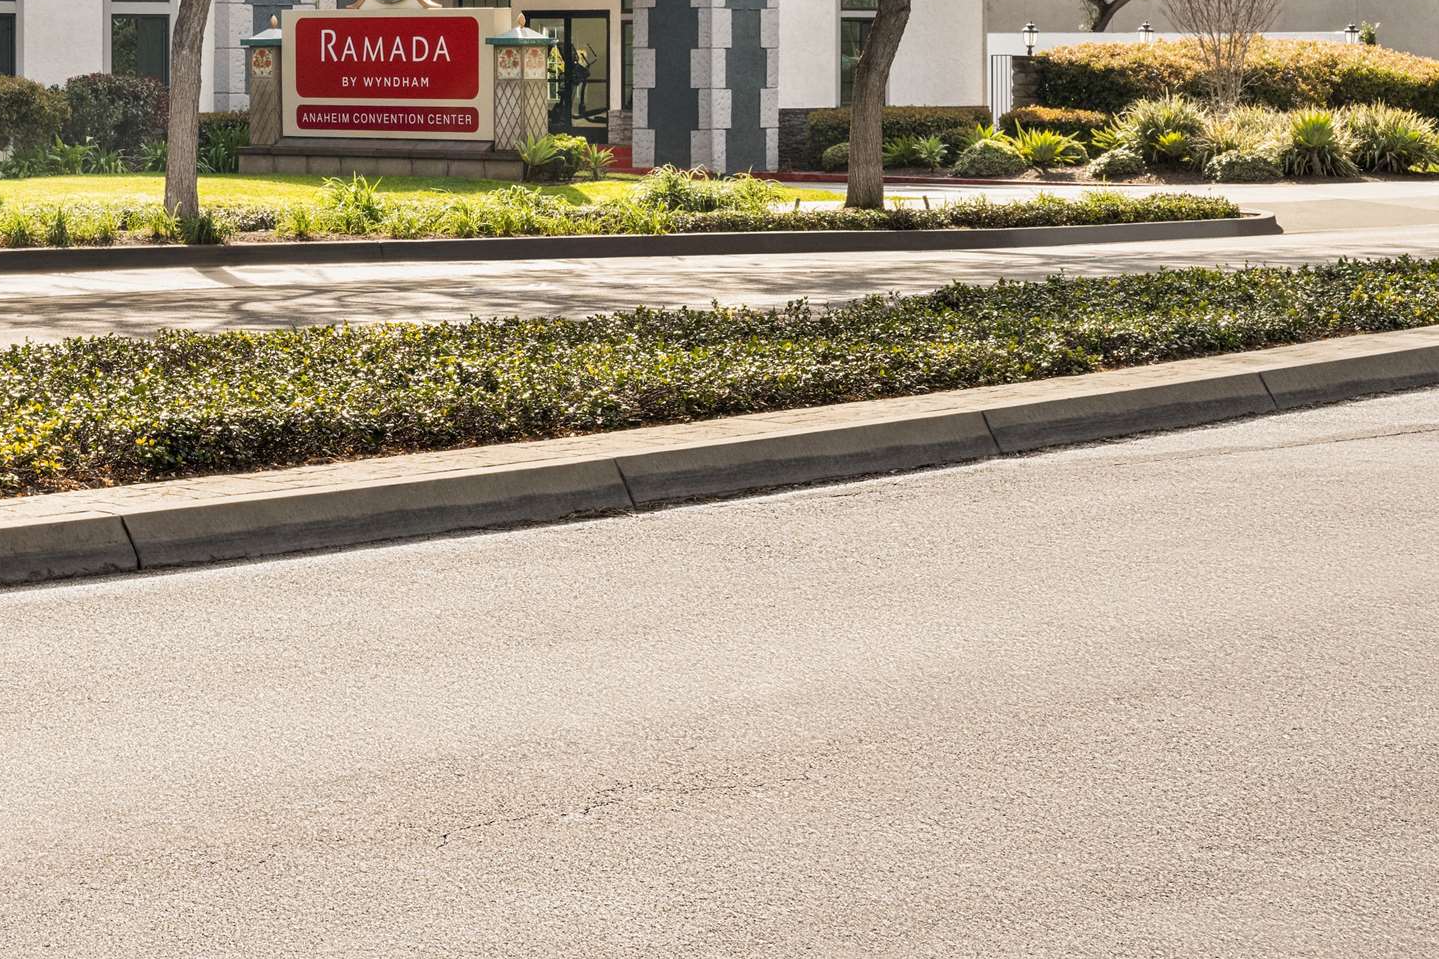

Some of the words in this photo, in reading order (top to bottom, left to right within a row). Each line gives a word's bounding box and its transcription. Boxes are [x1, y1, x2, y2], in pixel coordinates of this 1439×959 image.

[321, 29, 451, 62] RAMADA
[342, 77, 357, 87] BY
[363, 76, 430, 87] WYNDHAM
[302, 113, 350, 124] ANAHEIM
[353, 113, 424, 125] CONVENTION
[427, 114, 472, 126] CENTER
